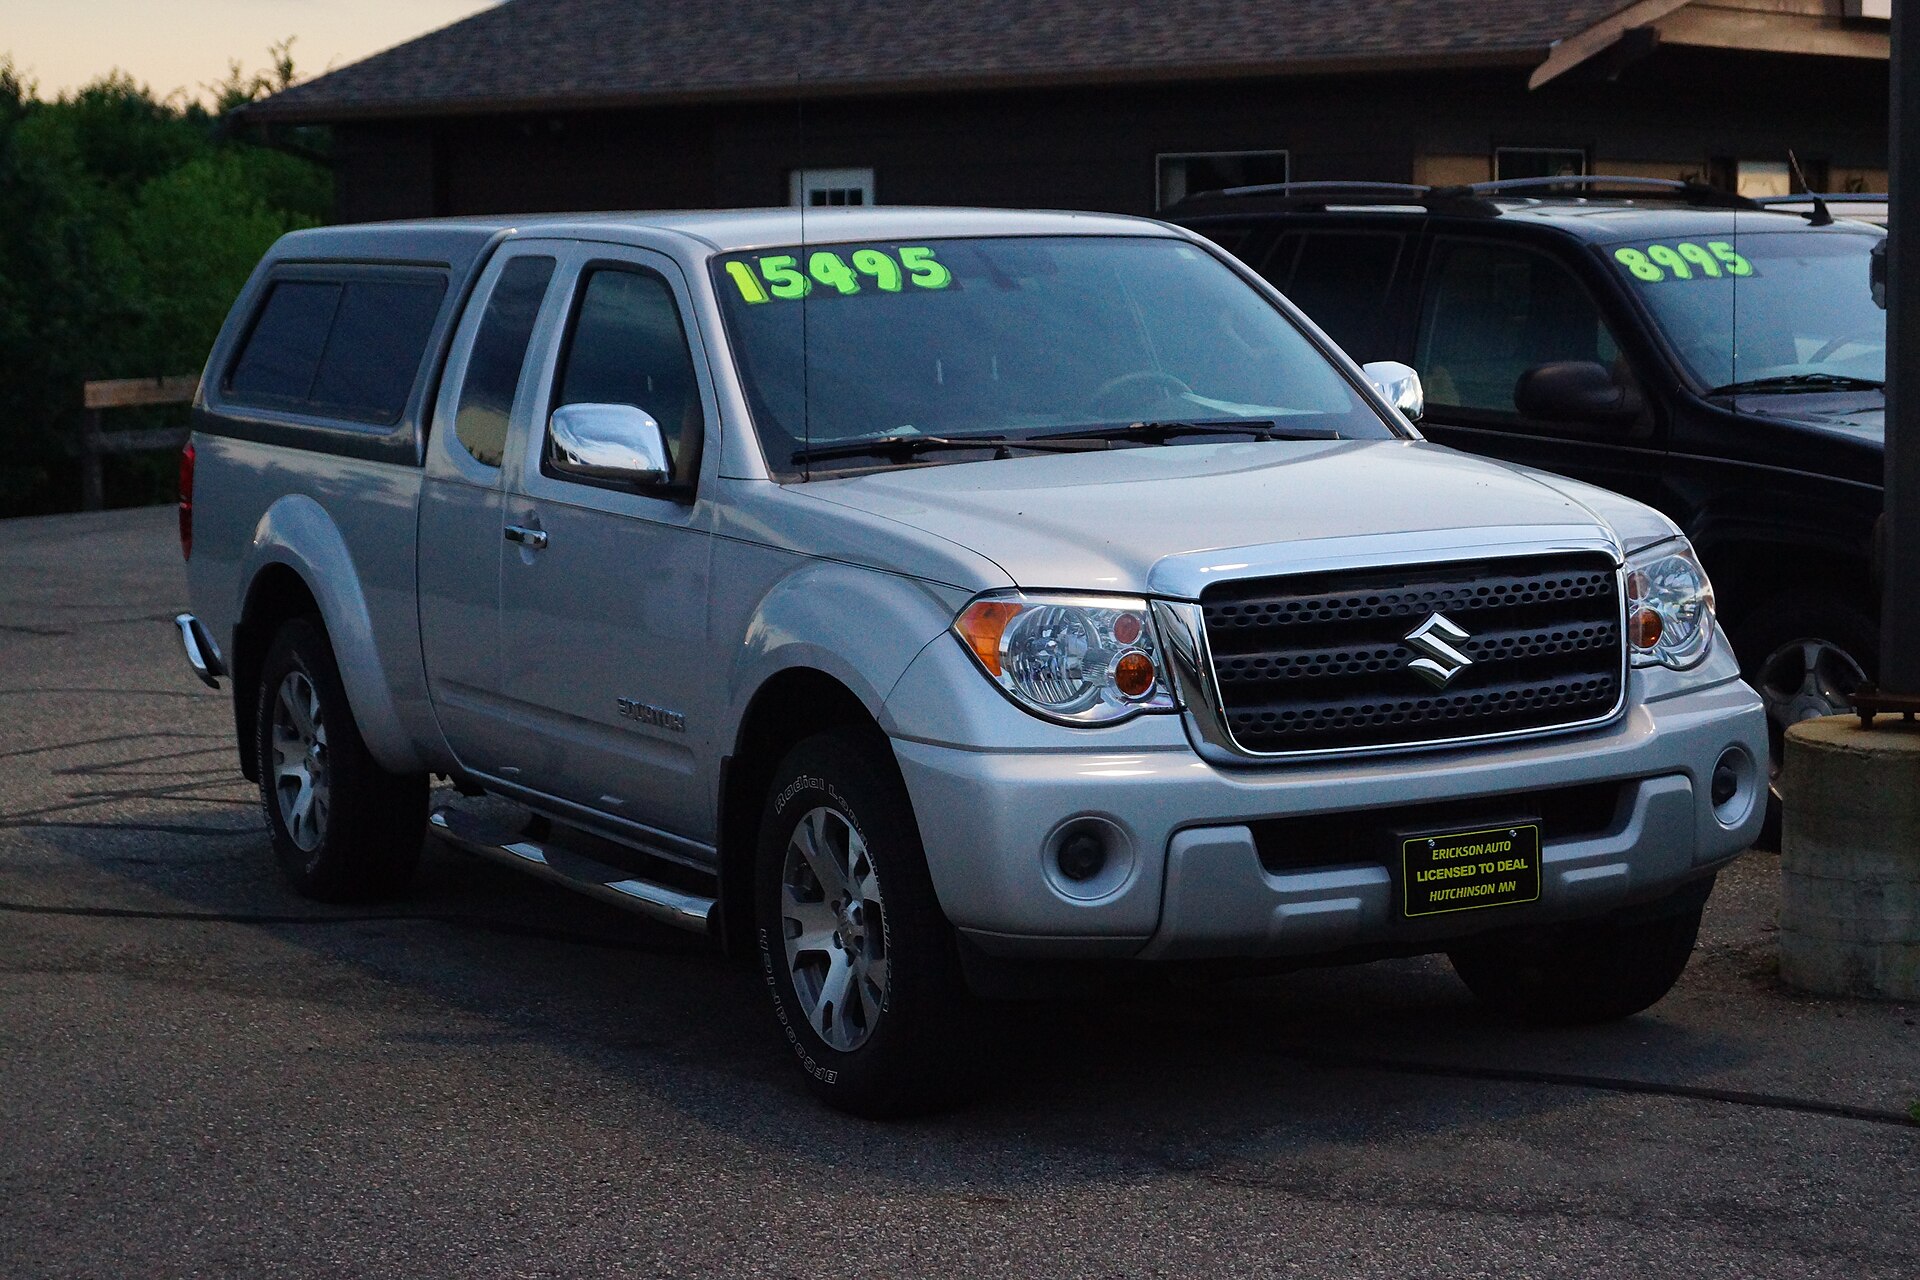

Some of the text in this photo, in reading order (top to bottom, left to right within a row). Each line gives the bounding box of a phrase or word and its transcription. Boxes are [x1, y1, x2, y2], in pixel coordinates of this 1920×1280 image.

[1614, 241, 1753, 282] 8995
[725, 247, 952, 304] 15495
[1432, 841, 1512, 860] ERICKSON AUTO
[1416, 858, 1528, 882] LICENSED TO DEAL
[1429, 881, 1516, 902] HUTCHINSON MN
